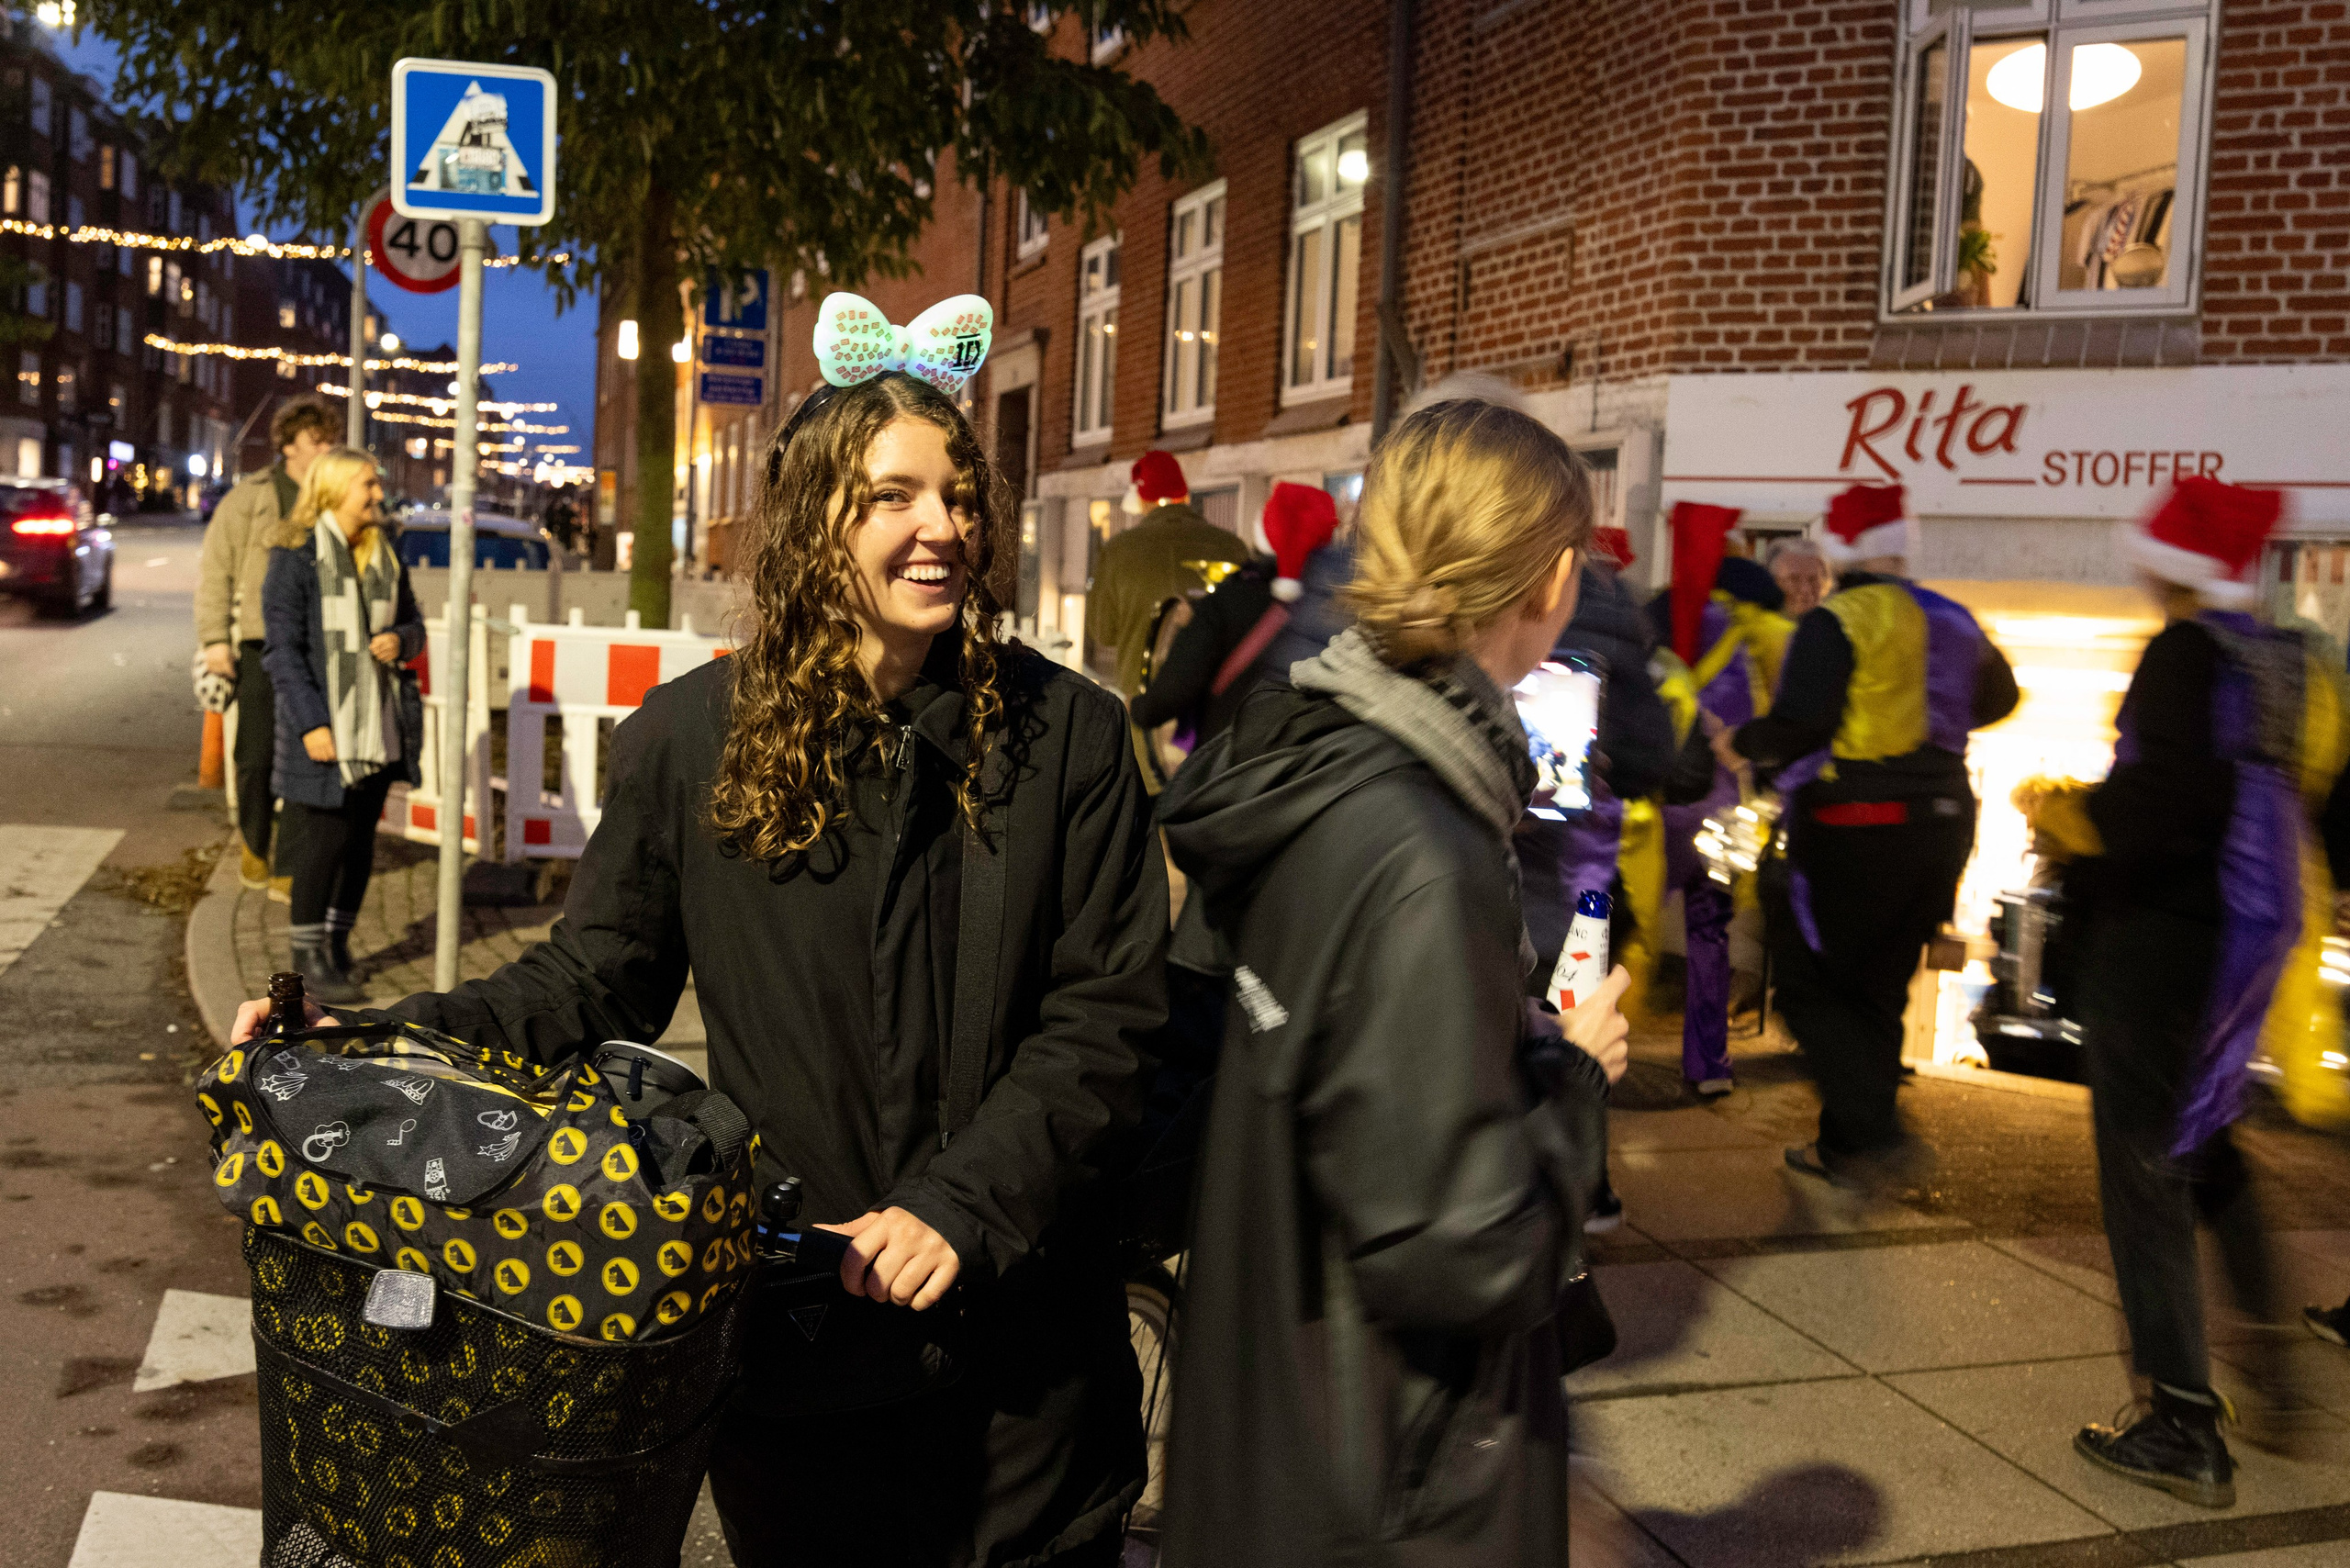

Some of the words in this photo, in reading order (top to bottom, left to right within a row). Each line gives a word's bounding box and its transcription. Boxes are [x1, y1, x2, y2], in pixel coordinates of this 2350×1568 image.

[388, 221, 457, 262] 40
[953, 340, 981, 367] 1D
[1840, 384, 2027, 479] Rita
[2042, 450, 2224, 487] STOFFER
